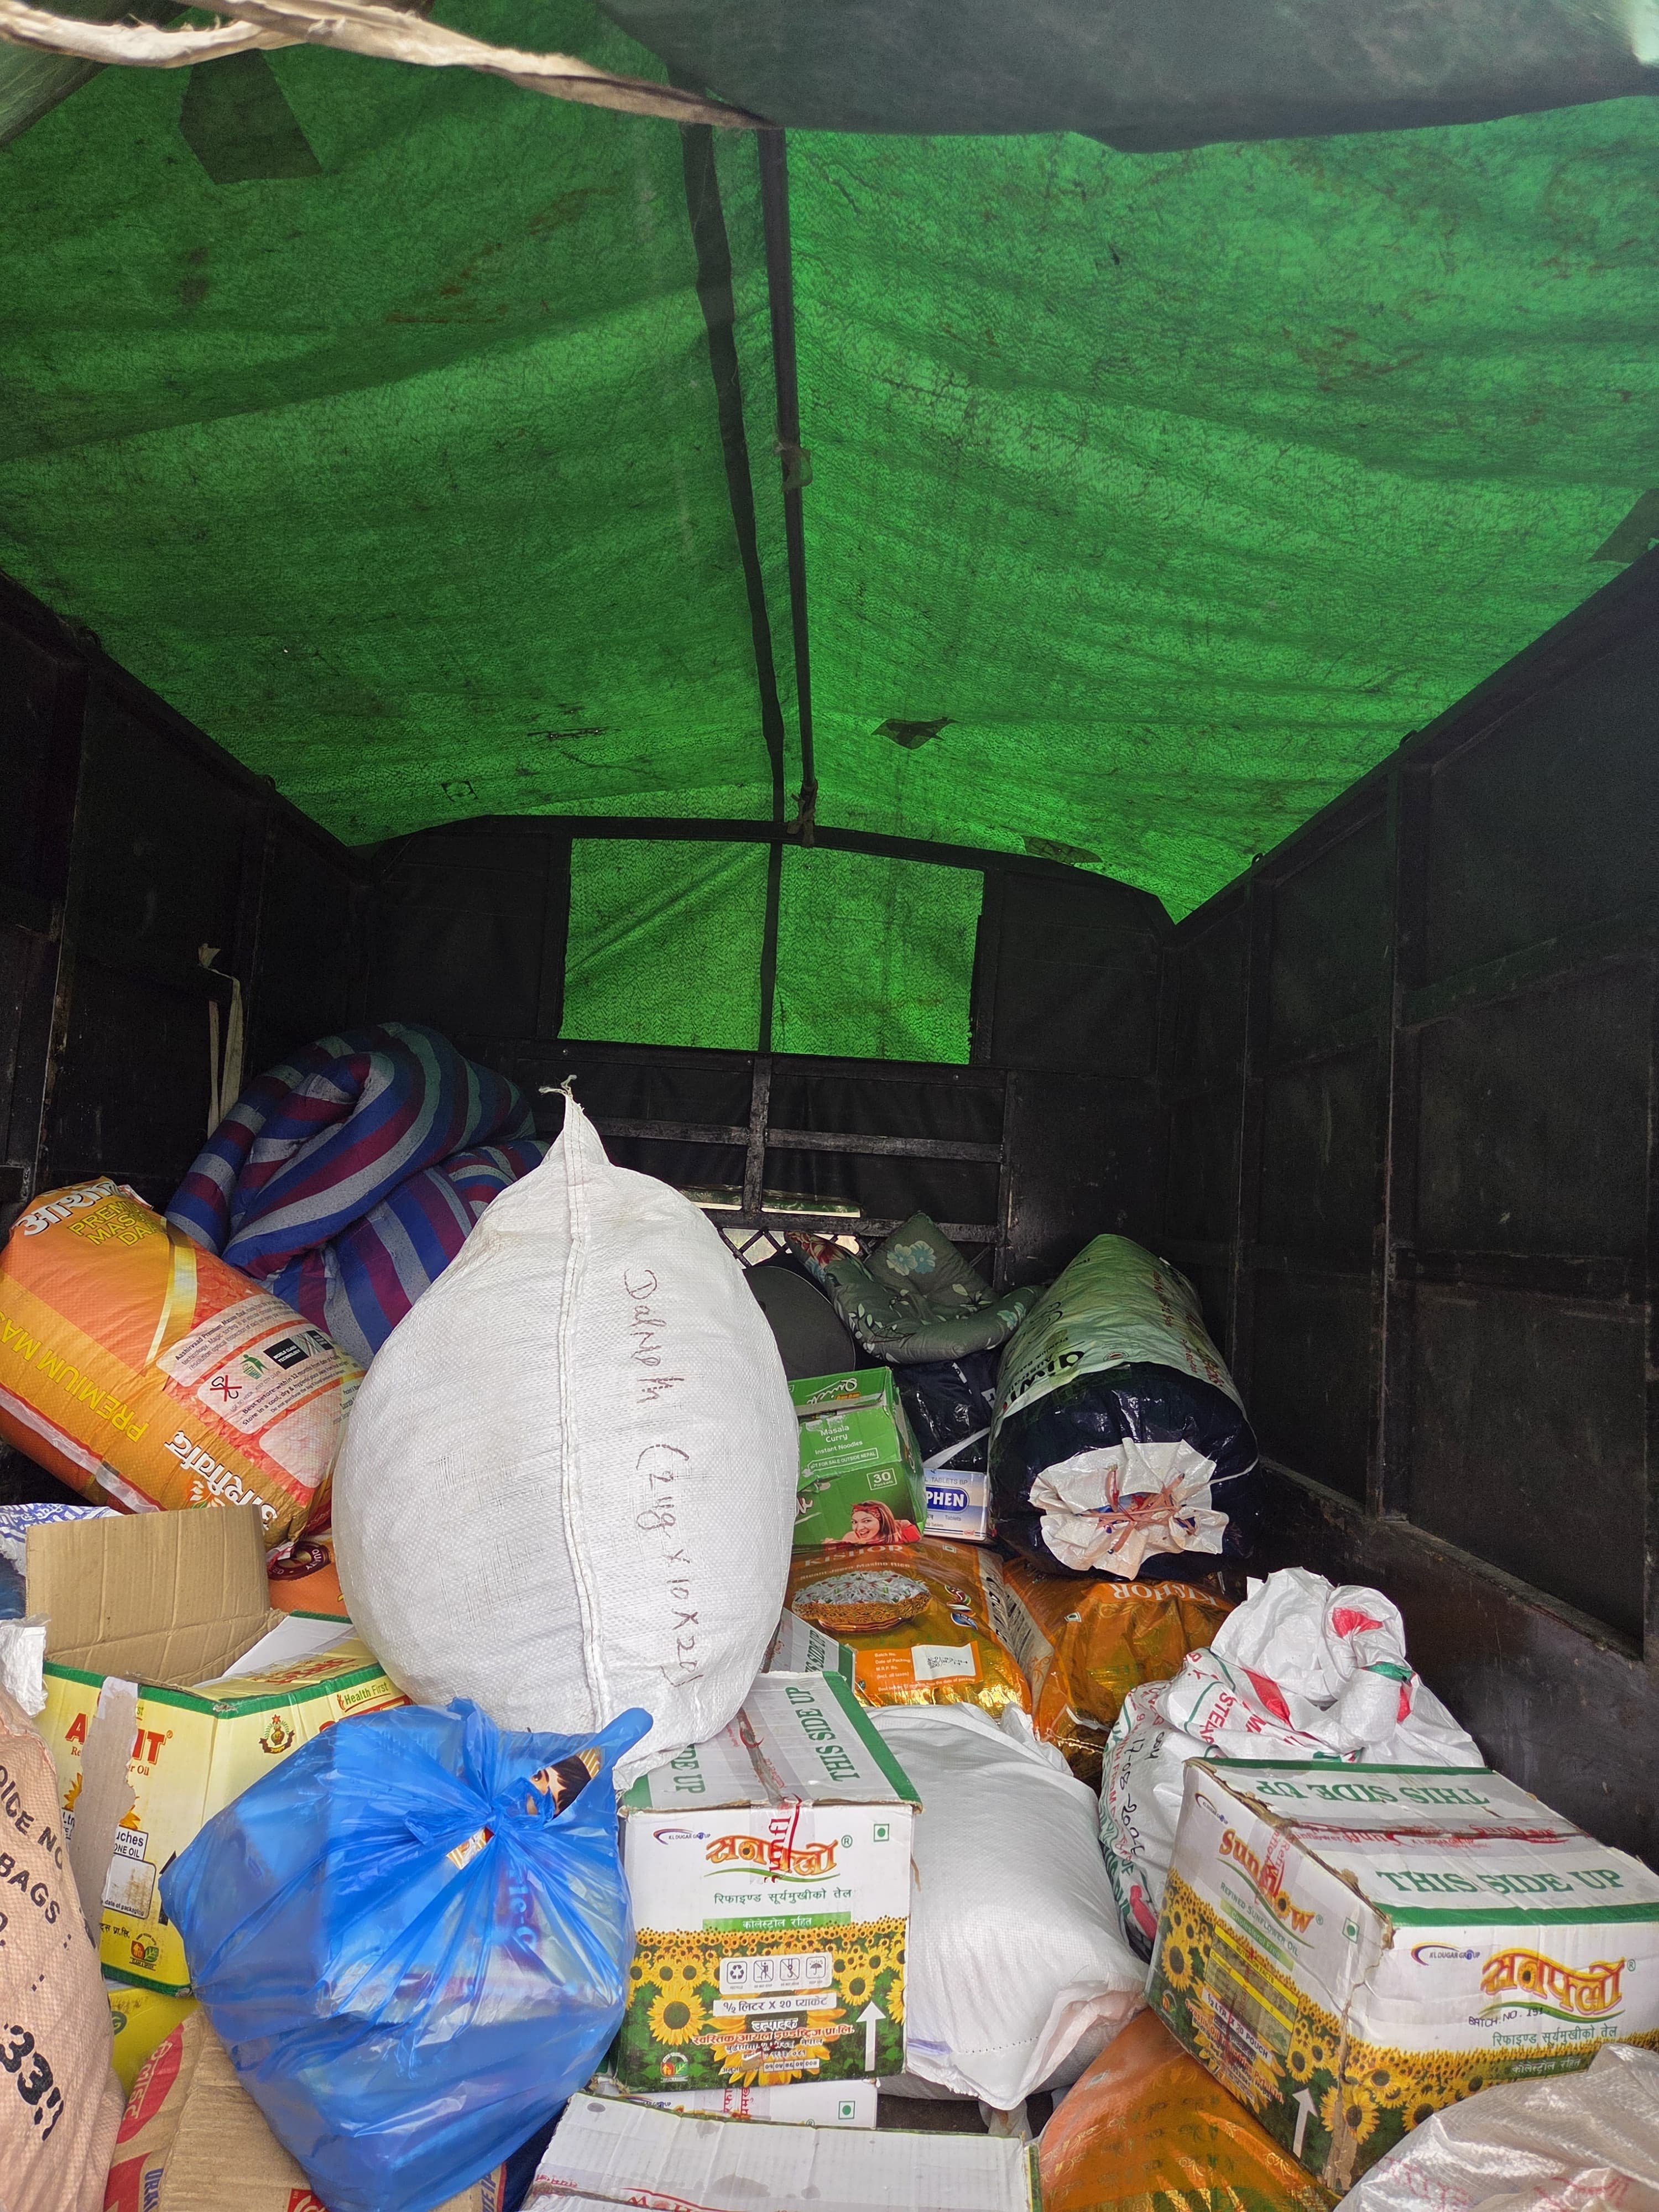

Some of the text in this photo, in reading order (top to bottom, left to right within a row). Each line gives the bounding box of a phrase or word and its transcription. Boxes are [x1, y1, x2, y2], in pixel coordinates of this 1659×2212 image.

[35, 1349, 150, 1443] PREMIUM
[242, 1400, 257, 1414] Best
[242, 1413, 258, 1426] Store
[820, 1425, 850, 1437] Masala
[825, 1433, 848, 1443] Curry
[815, 1440, 863, 1455] Instant Noodles
[860, 1451, 876, 1459] NEPAL
[873, 1472, 892, 1483] 30
[931, 1476, 958, 1485] TABLETS
[344, 1681, 389, 1705] Health First
[785, 1686, 860, 1783] THIS SIDE UP
[137, 1764, 150, 1777] Oil
[672, 1773, 706, 1794] UP
[1256, 1780, 1489, 1805] THIS SIDE UP
[128, 1847, 140, 1858] OIL
[1376, 1869, 1624, 1893] THIS SIDE UP
[713, 1886, 852, 1906] रिफाइण्ड सूर्यमुखीको तेल
[791, 1916, 812, 1927] रहित
[1220, 1881, 1300, 1957] REFINED SUNFLOWER OIL
[1265, 1938, 1280, 1959] Free
[1438, 1951, 1458, 1959] DUGAR
[738, 1999, 764, 2012] लिटर
[752, 2018, 799, 2032] उत्पादक
[738, 2032, 774, 2042] आयल
[1493, 2022, 1618, 2047] रिफाइण्ड सूर्यमुखीको तेल
[1245, 2031, 1269, 2059] POUCH
[1560, 2057, 1581, 2069] रहित
